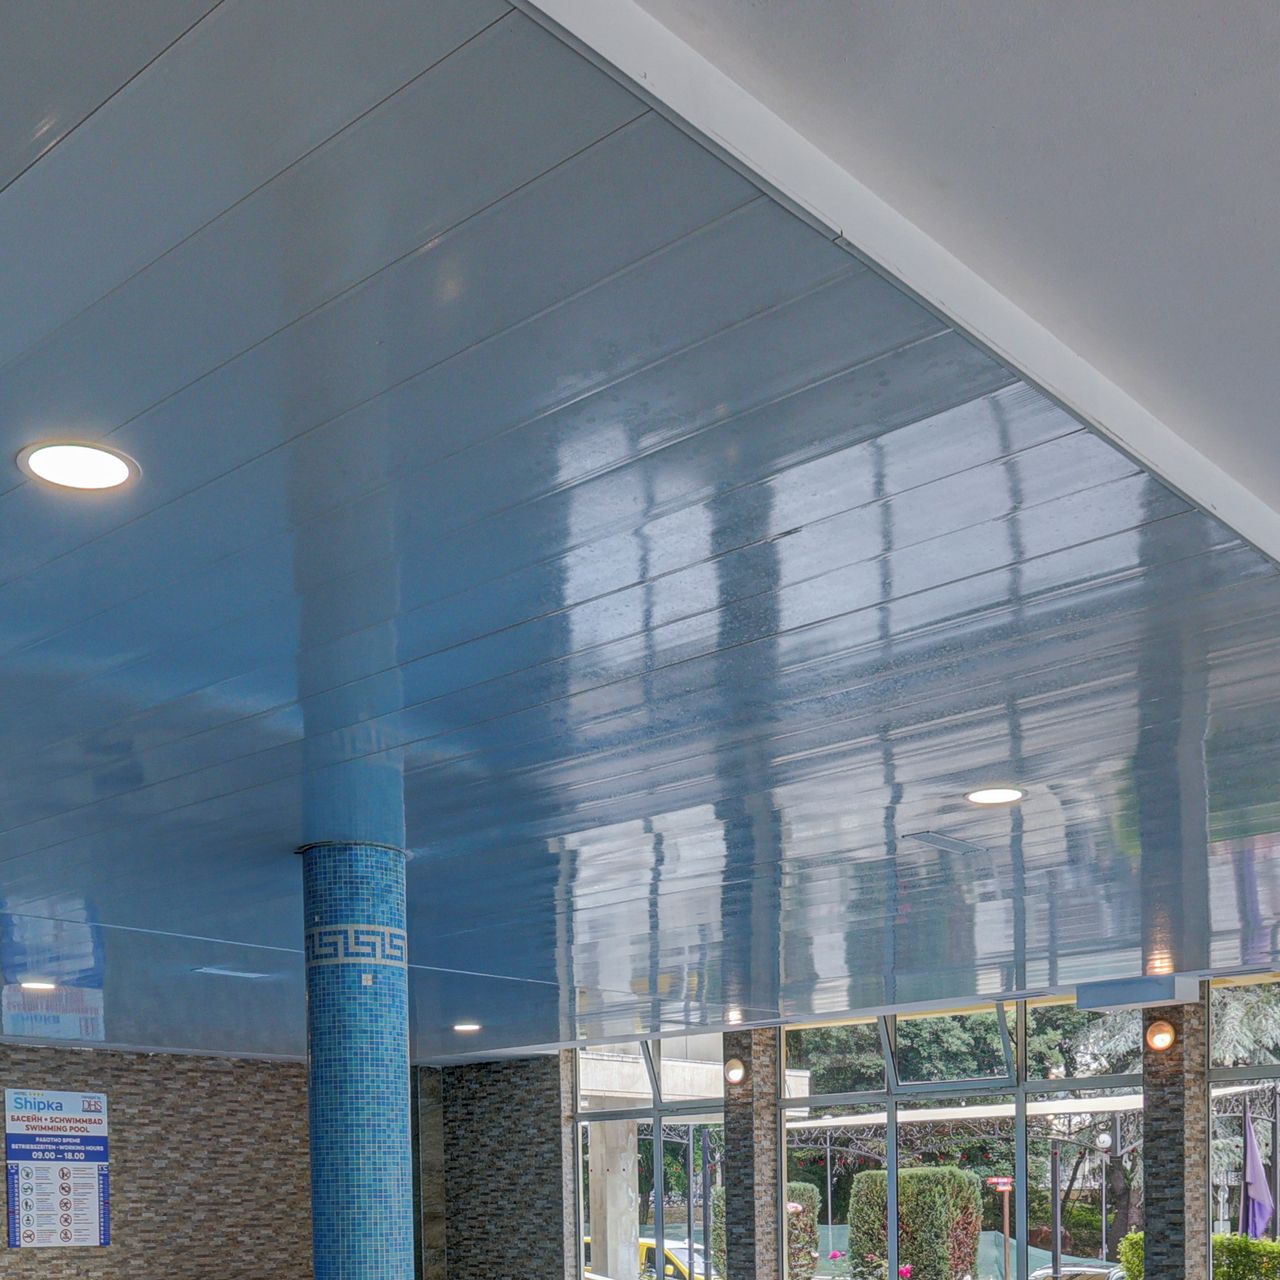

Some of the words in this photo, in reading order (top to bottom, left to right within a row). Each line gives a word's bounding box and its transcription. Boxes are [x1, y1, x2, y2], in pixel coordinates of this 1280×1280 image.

[14, 1097, 63, 1112] Shipka
[82, 1100, 102, 1110] DHS
[10, 1114, 42, 1122] БАСЕЙН
[50, 1117, 103, 1125] SCHWIMMBAD
[32, 1151, 55, 1159] 09.00
